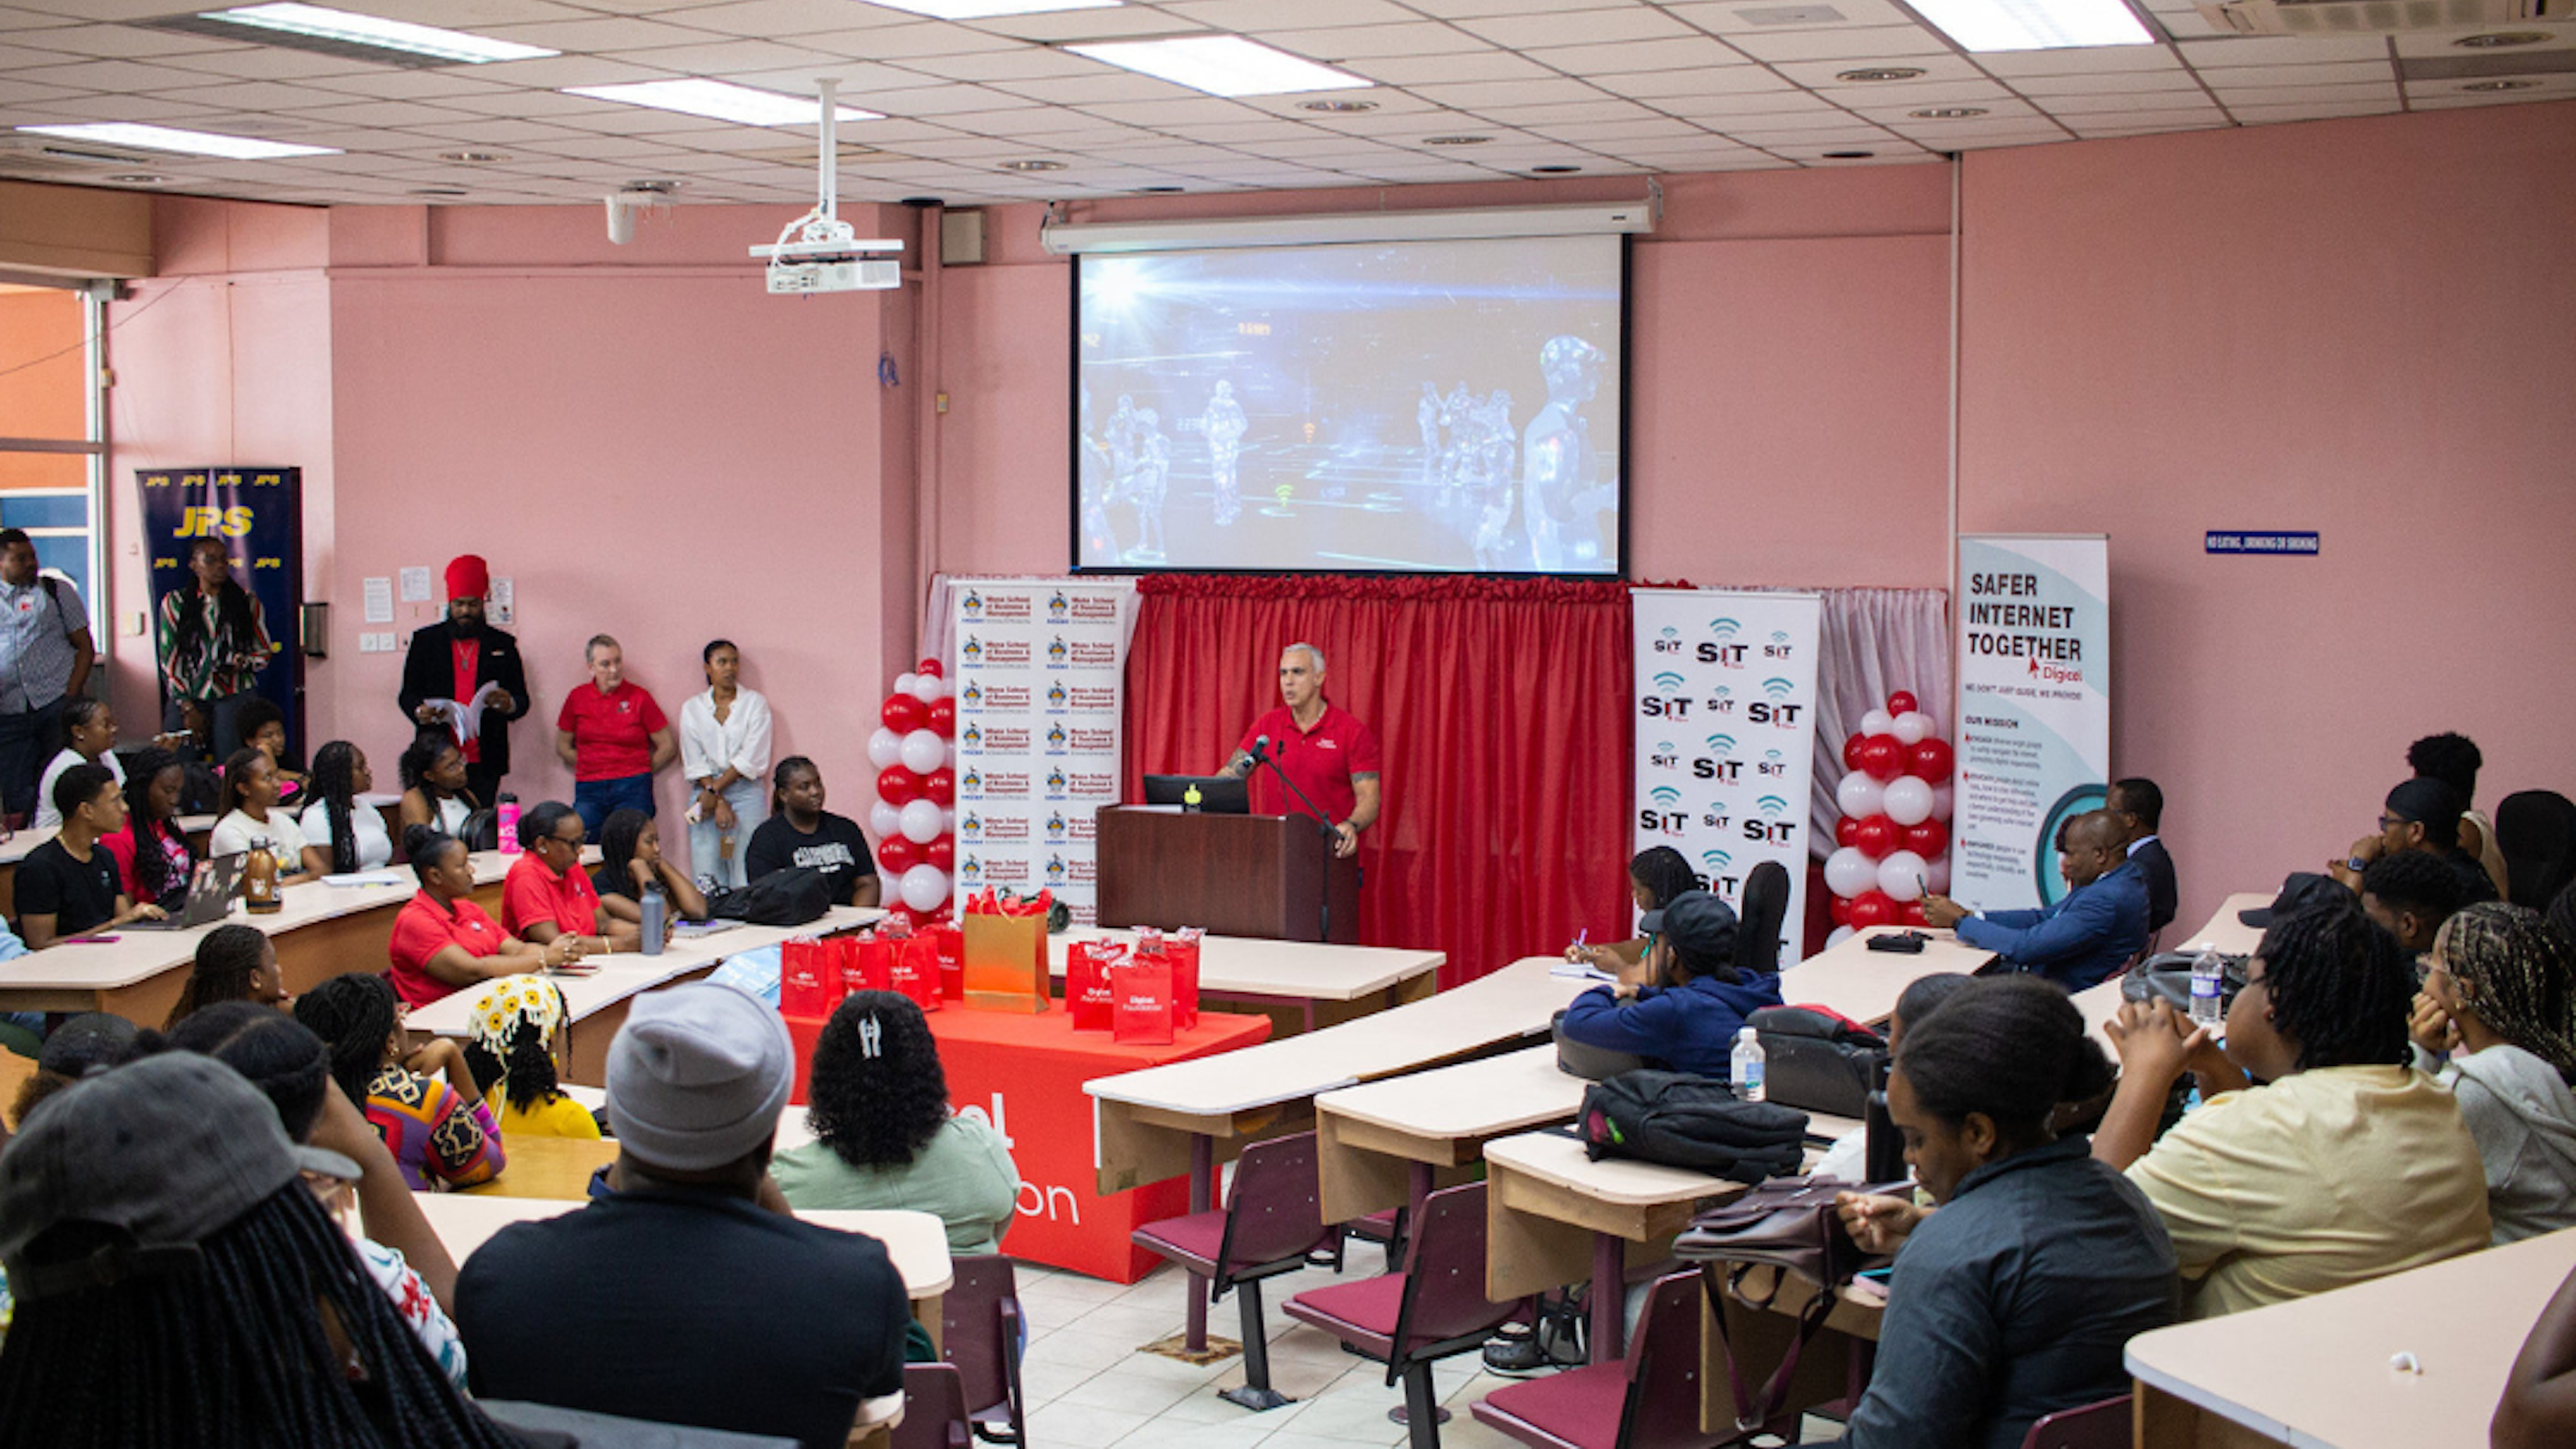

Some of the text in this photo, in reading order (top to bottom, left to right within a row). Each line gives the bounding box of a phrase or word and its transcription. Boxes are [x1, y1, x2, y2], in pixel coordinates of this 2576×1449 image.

[146, 476, 170, 486] JPS
[181, 474, 206, 486] JPS
[217, 474, 241, 486] JPS
[254, 474, 280, 486] JPS
[173, 506, 254, 537] JPS
[154, 557, 178, 568] JPS
[254, 557, 281, 568] JPS
[1971, 574, 2037, 596] SAFER
[1970, 602, 2074, 629] INTERNET
[1968, 633, 2082, 661] TOGETHER
[2043, 667, 2082, 683] Digicel
[1966, 715, 2019, 729] OUR MISSION
